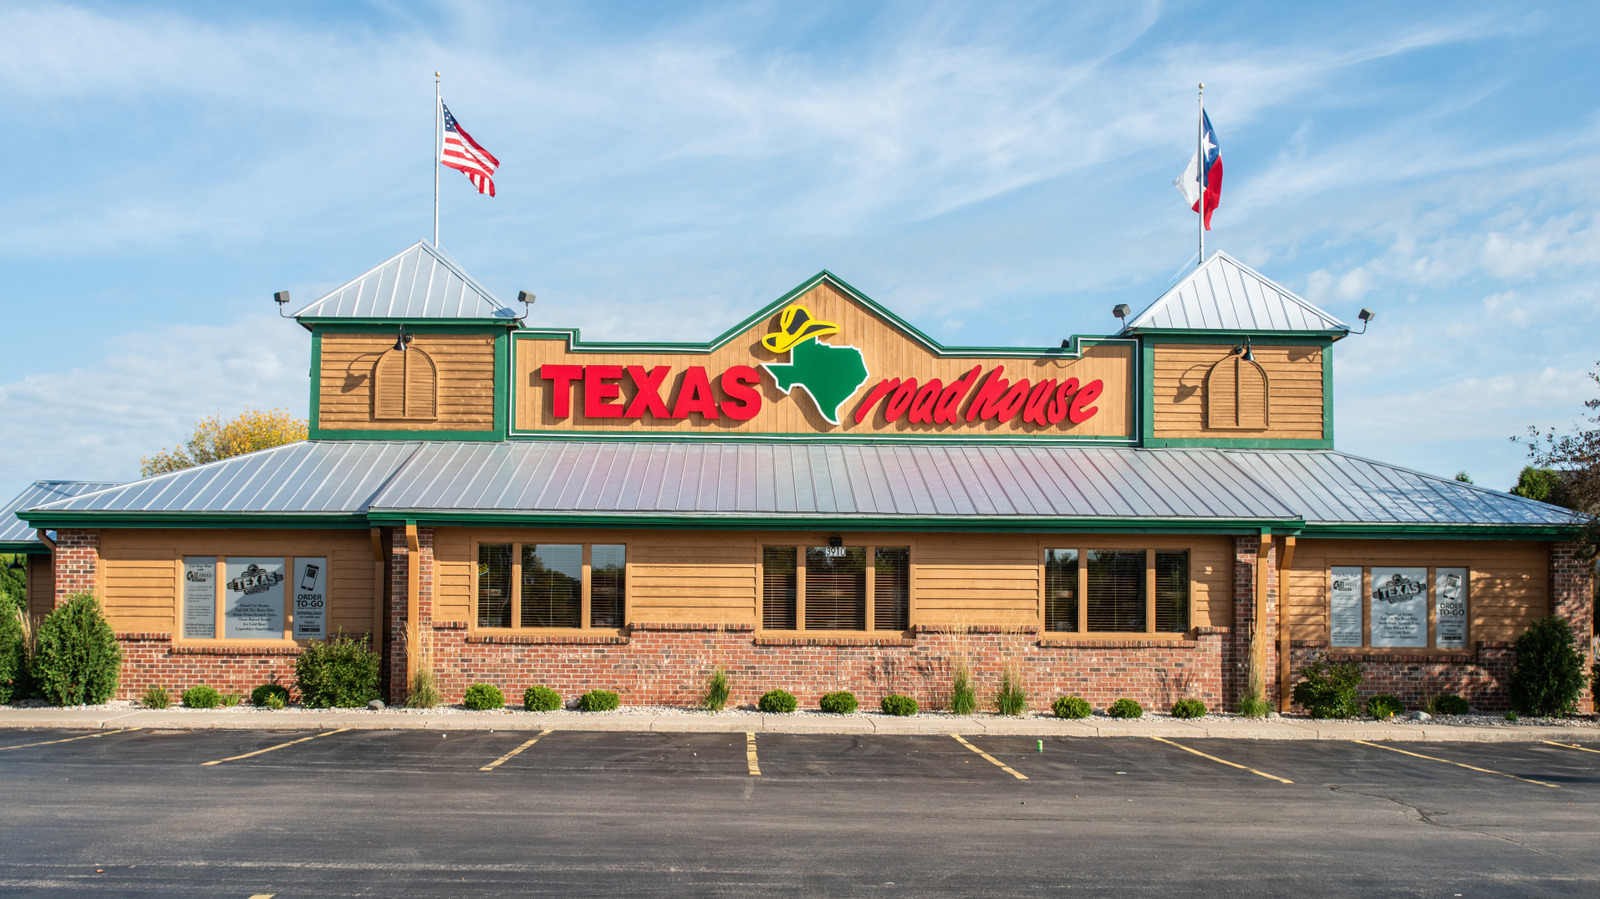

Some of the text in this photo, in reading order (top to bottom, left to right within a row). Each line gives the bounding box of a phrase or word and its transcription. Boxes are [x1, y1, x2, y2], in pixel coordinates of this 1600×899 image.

[541, 364, 1104, 426] TEXAS roadhouse
[826, 546, 846, 556] 3910
[234, 572, 276, 590] TEXAS
[1379, 582, 1420, 599] TEXAS
